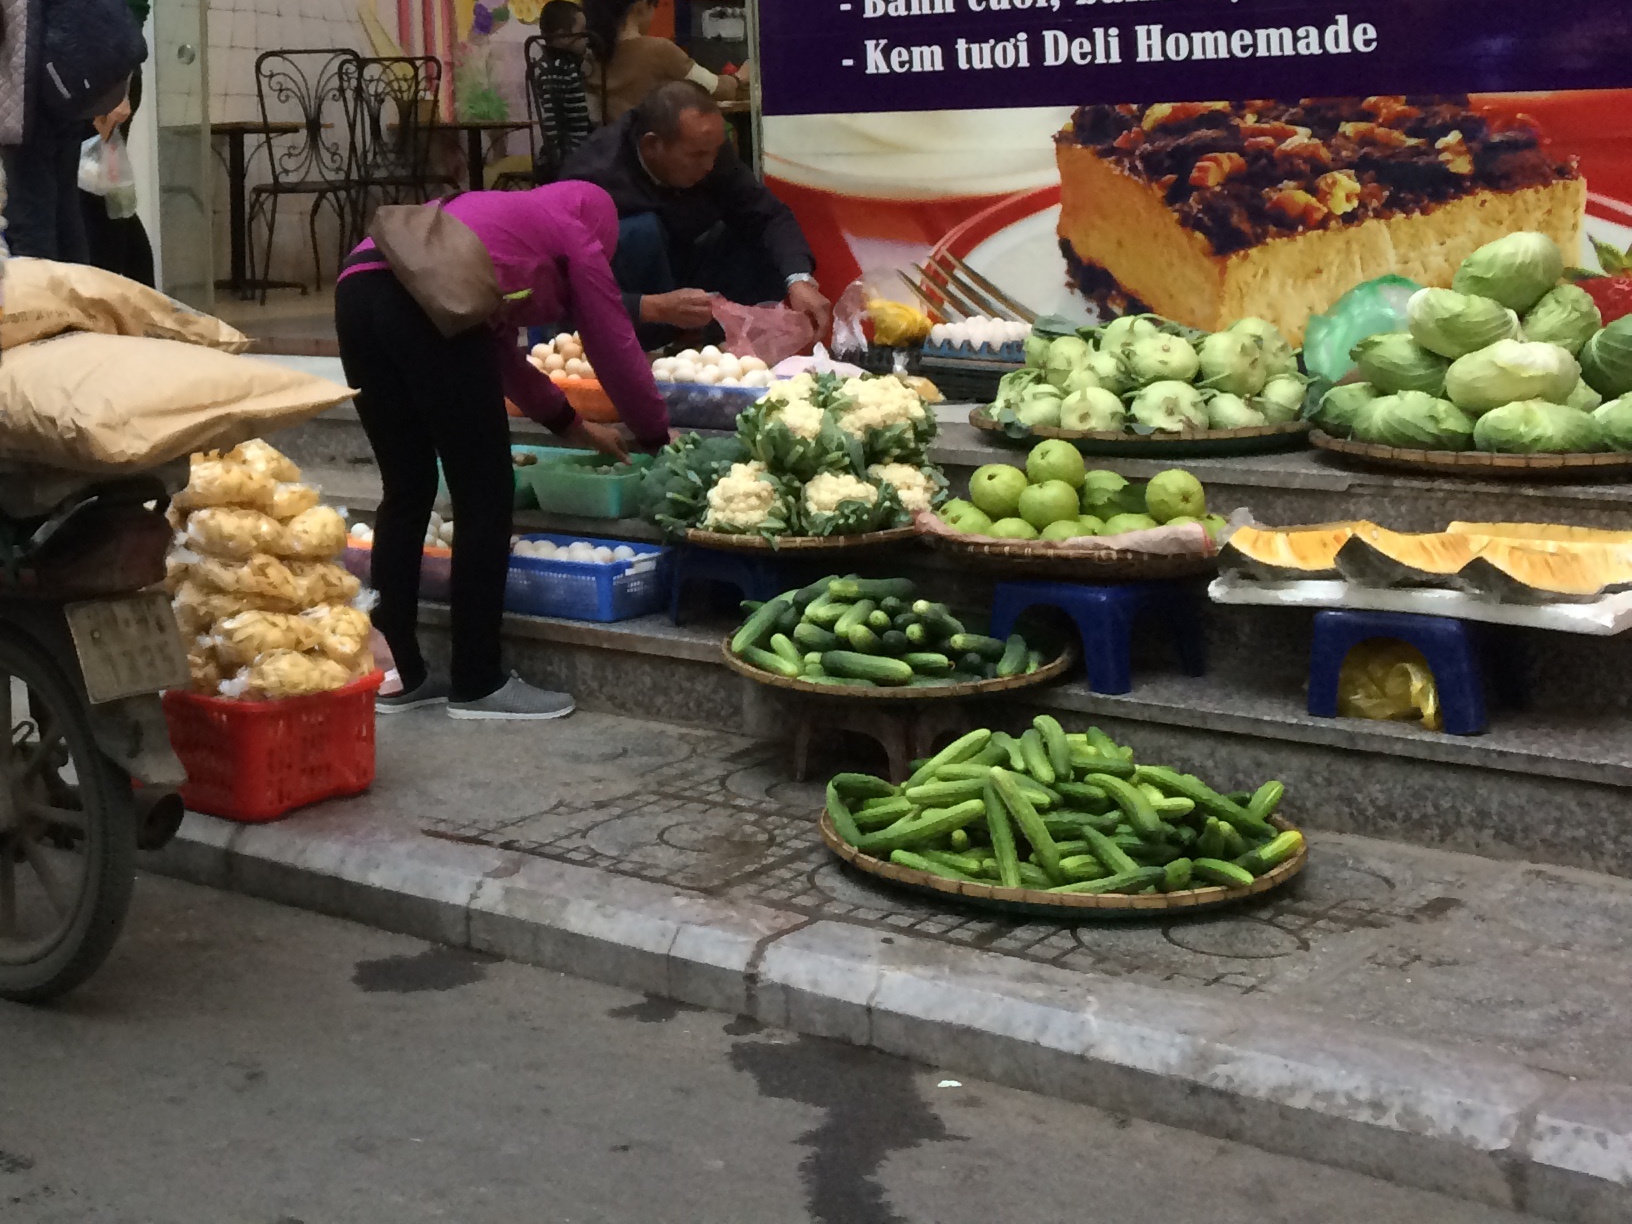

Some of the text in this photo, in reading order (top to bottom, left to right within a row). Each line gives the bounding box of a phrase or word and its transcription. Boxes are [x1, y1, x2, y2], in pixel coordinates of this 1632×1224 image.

[865, 14, 1378, 74] Kem tươi Deli Homemade
